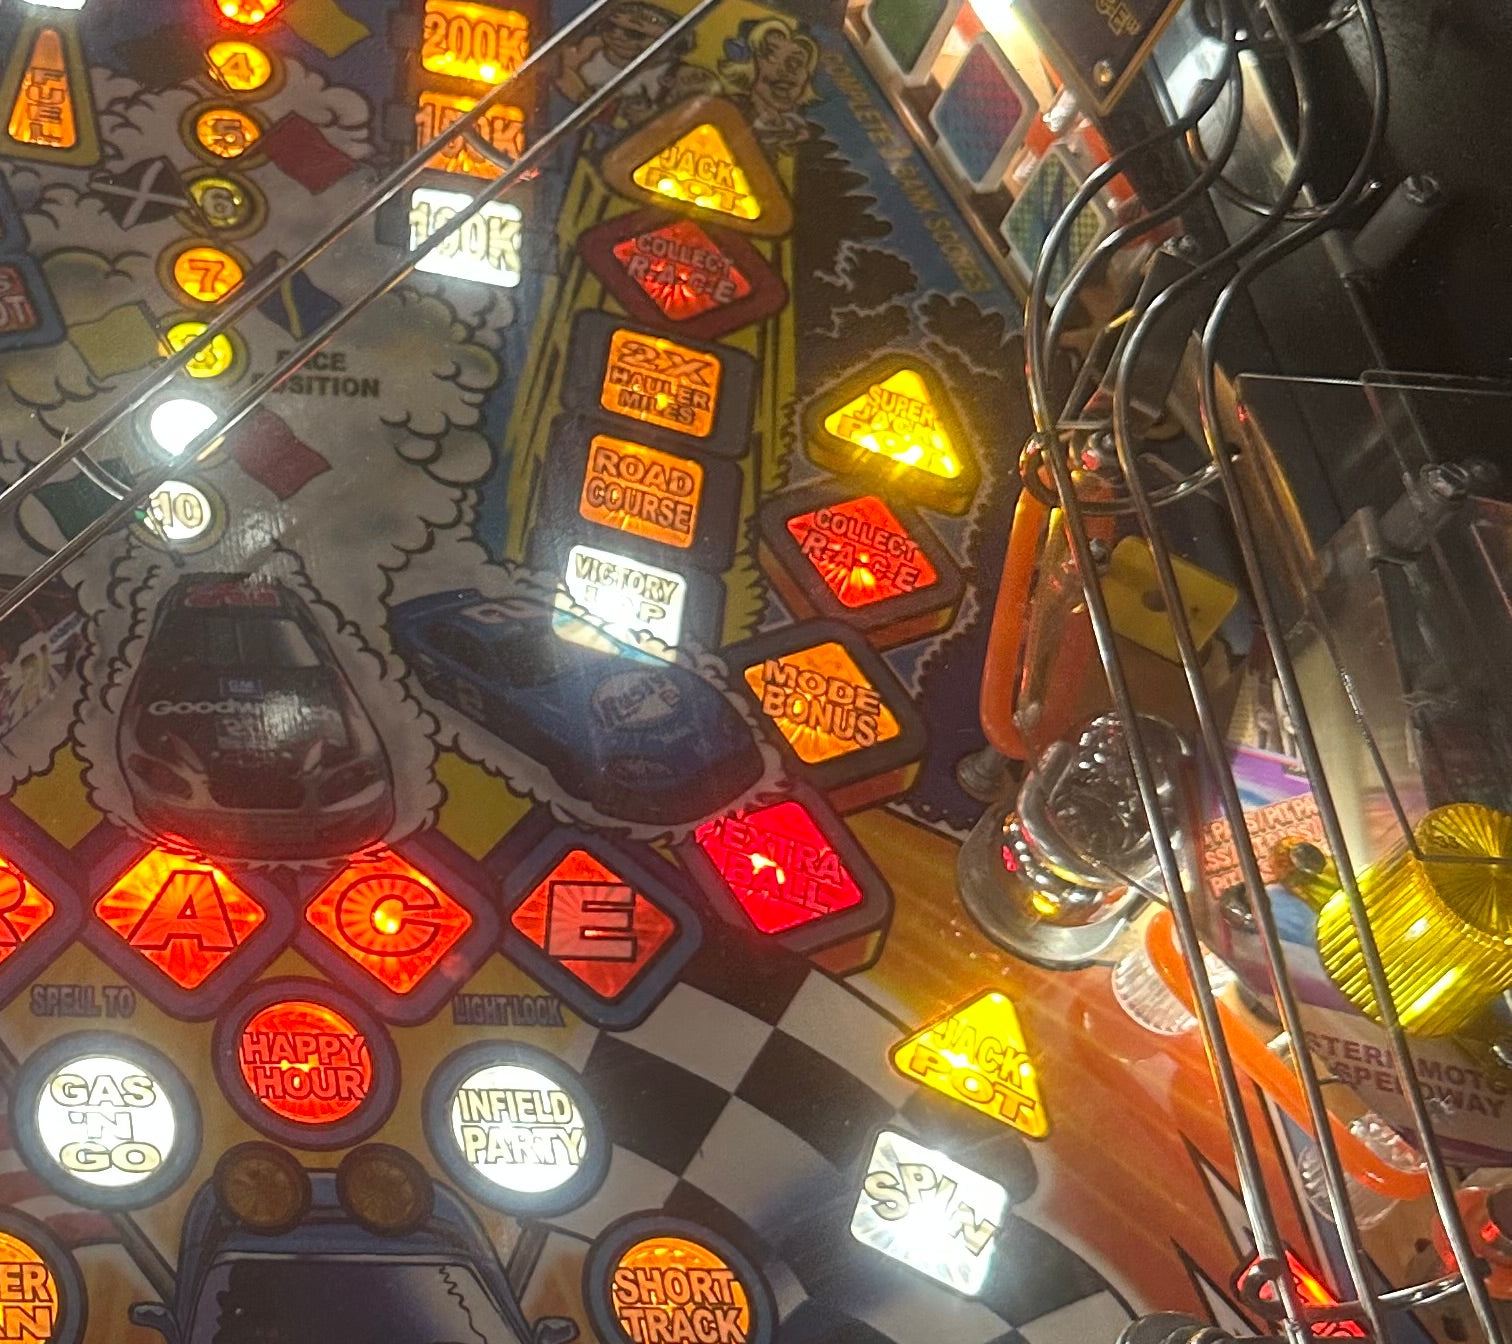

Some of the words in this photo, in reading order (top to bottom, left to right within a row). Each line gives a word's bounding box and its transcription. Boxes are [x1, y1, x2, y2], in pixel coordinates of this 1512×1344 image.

[424, 11, 530, 66] 200K
[223, 50, 255, 85] 4
[26, 66, 67, 143] FUEL
[213, 117, 245, 151] 5
[659, 146, 737, 189] JACK
[200, 184, 234, 223] 6
[646, 175, 749, 218] POT
[189, 258, 225, 293] 7
[636, 230, 735, 278] COLLECT
[626, 253, 735, 306] R-A-C-E
[615, 339, 715, 388] 2X
[610, 366, 712, 411] HAULER
[617, 390, 698, 426] MILES
[866, 381, 936, 429] SUPER
[855, 401, 948, 453] JACK
[593, 448, 696, 500] ROAD
[155, 492, 203, 528] 10
[586, 476, 695, 533] COURSE
[813, 506, 921, 563] COLLECT
[574, 554, 680, 605] VICTORY
[801, 529, 918, 594] R-A-C-E
[761, 659, 883, 717] MODE
[762, 690, 879, 748] BONUS
[722, 816, 843, 885] EXTRA
[724, 852, 830, 915] BALL
[29, 985, 101, 1016] SPELL
[103, 987, 136, 1019] TO
[454, 995, 517, 1025] LIGHT
[515, 996, 565, 1027] LOCK
[242, 1031, 366, 1065] HAPPY
[932, 1016, 1031, 1091] JACK
[50, 1074, 156, 1108] GAS
[255, 1066, 366, 1101] HOUR
[909, 1043, 1038, 1123] POT
[70, 1111, 135, 1141] 'N
[458, 1089, 573, 1125] INFIELD
[60, 1142, 162, 1174] GO
[462, 1126, 584, 1166] PARTY
[864, 1161, 999, 1256] SPIN
[615, 1268, 736, 1307] SHORT
